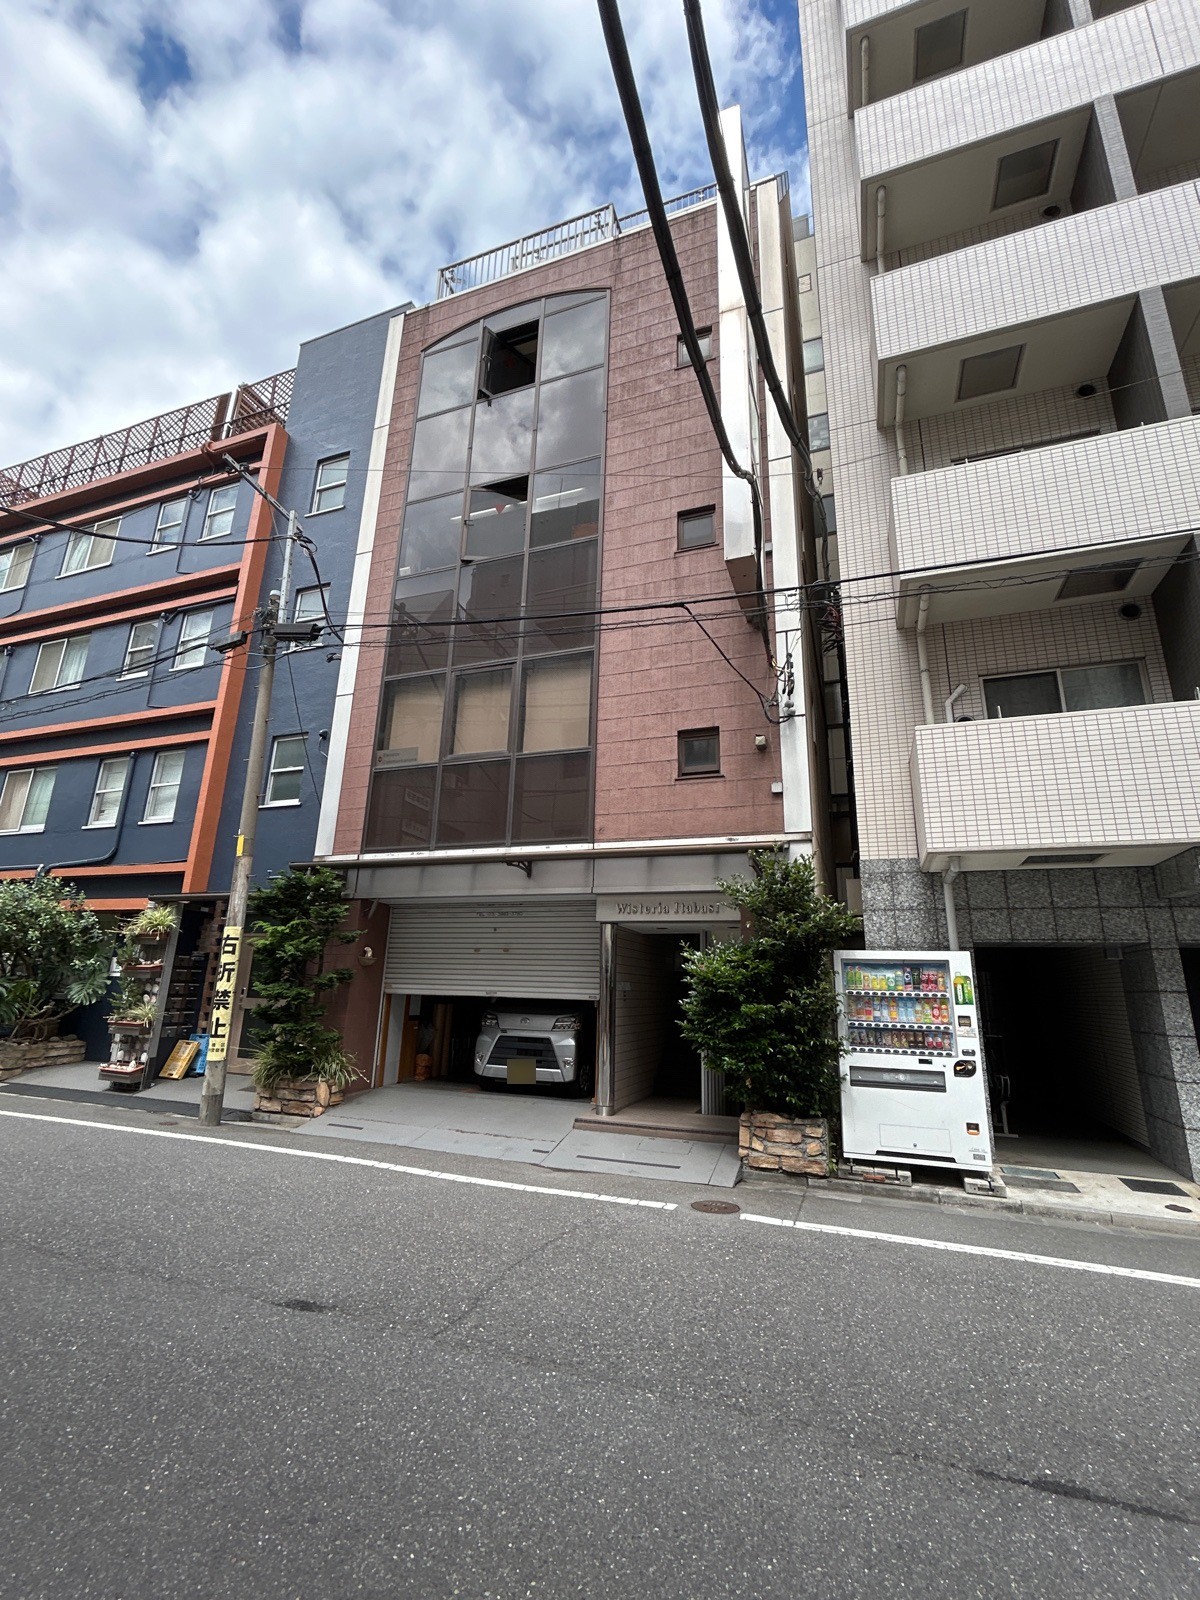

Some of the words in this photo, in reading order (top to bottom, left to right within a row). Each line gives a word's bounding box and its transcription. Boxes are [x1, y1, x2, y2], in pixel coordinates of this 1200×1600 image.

[616, 902, 670, 915] Wisteria
[210, 934, 239, 1038] 右折禁止
